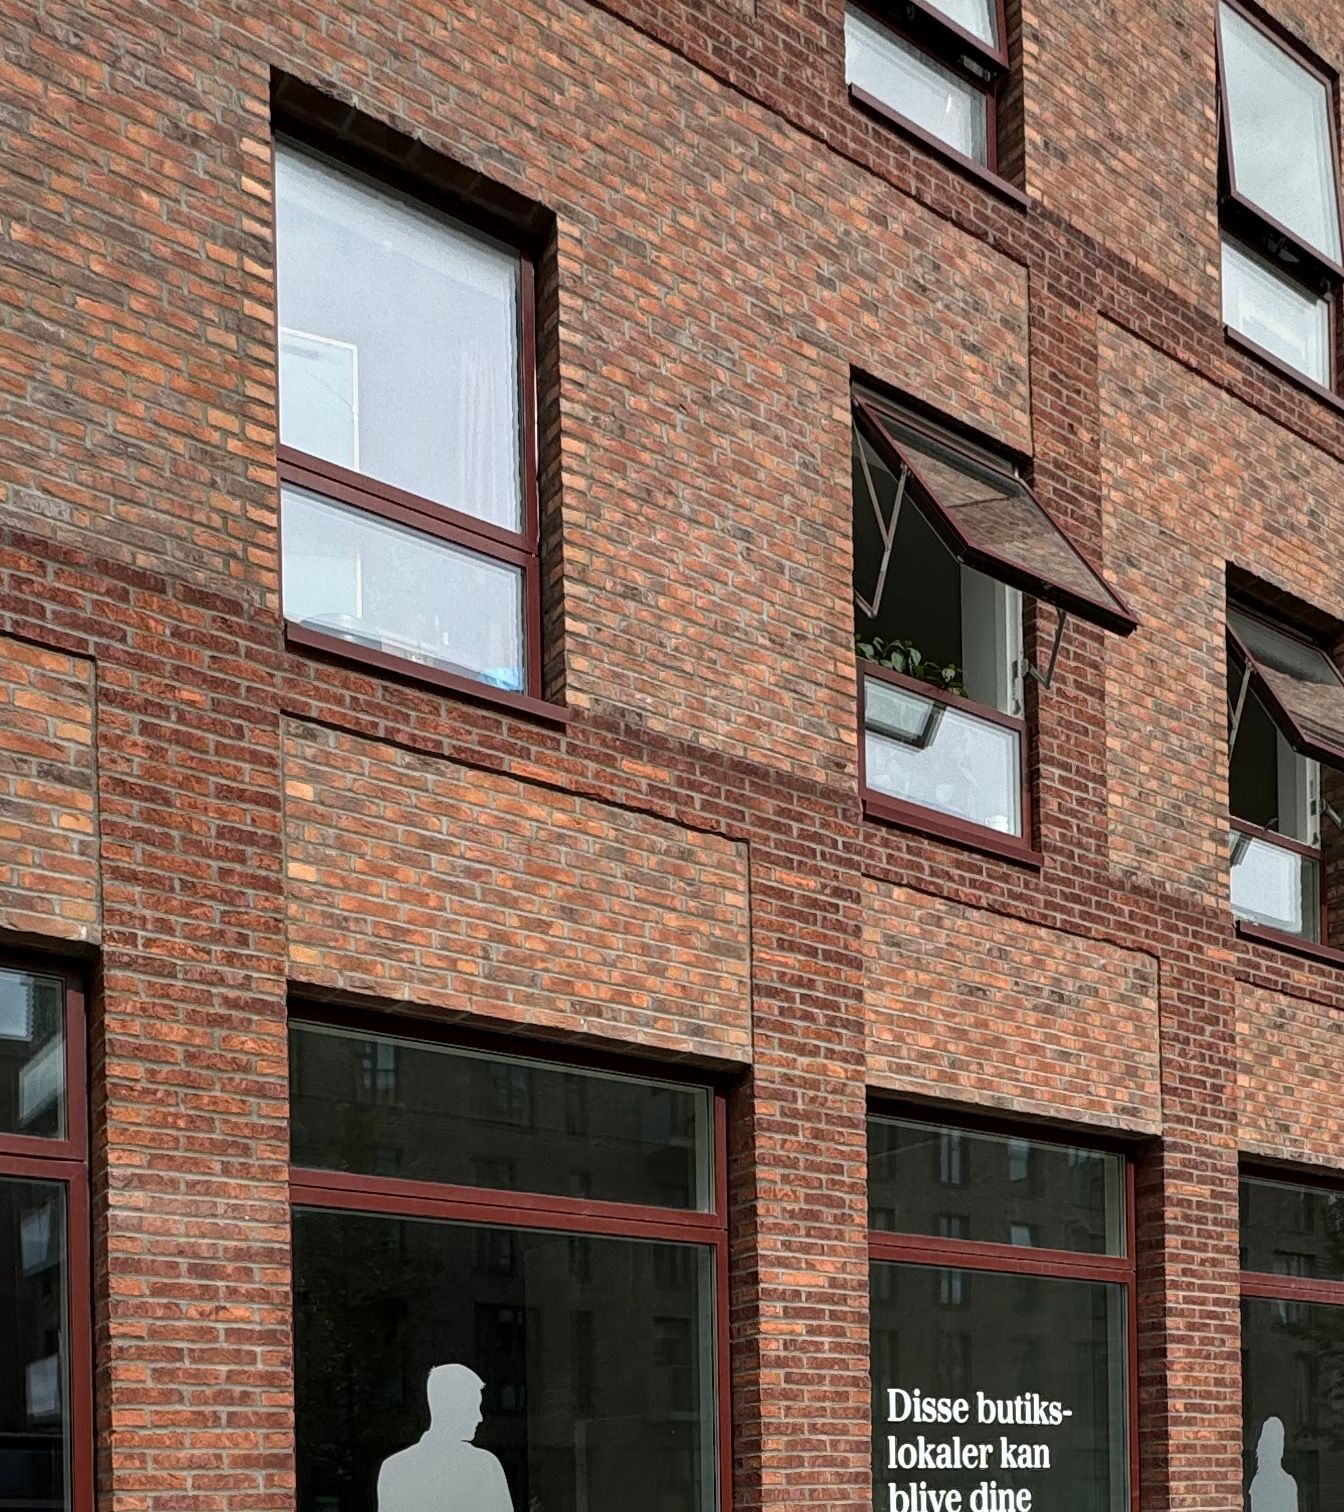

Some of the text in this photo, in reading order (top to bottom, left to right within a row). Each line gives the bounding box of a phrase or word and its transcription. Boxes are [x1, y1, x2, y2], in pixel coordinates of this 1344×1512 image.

[886, 1388, 1072, 1425] Disse butiks-
[887, 1435, 1051, 1470] lokaler kan
